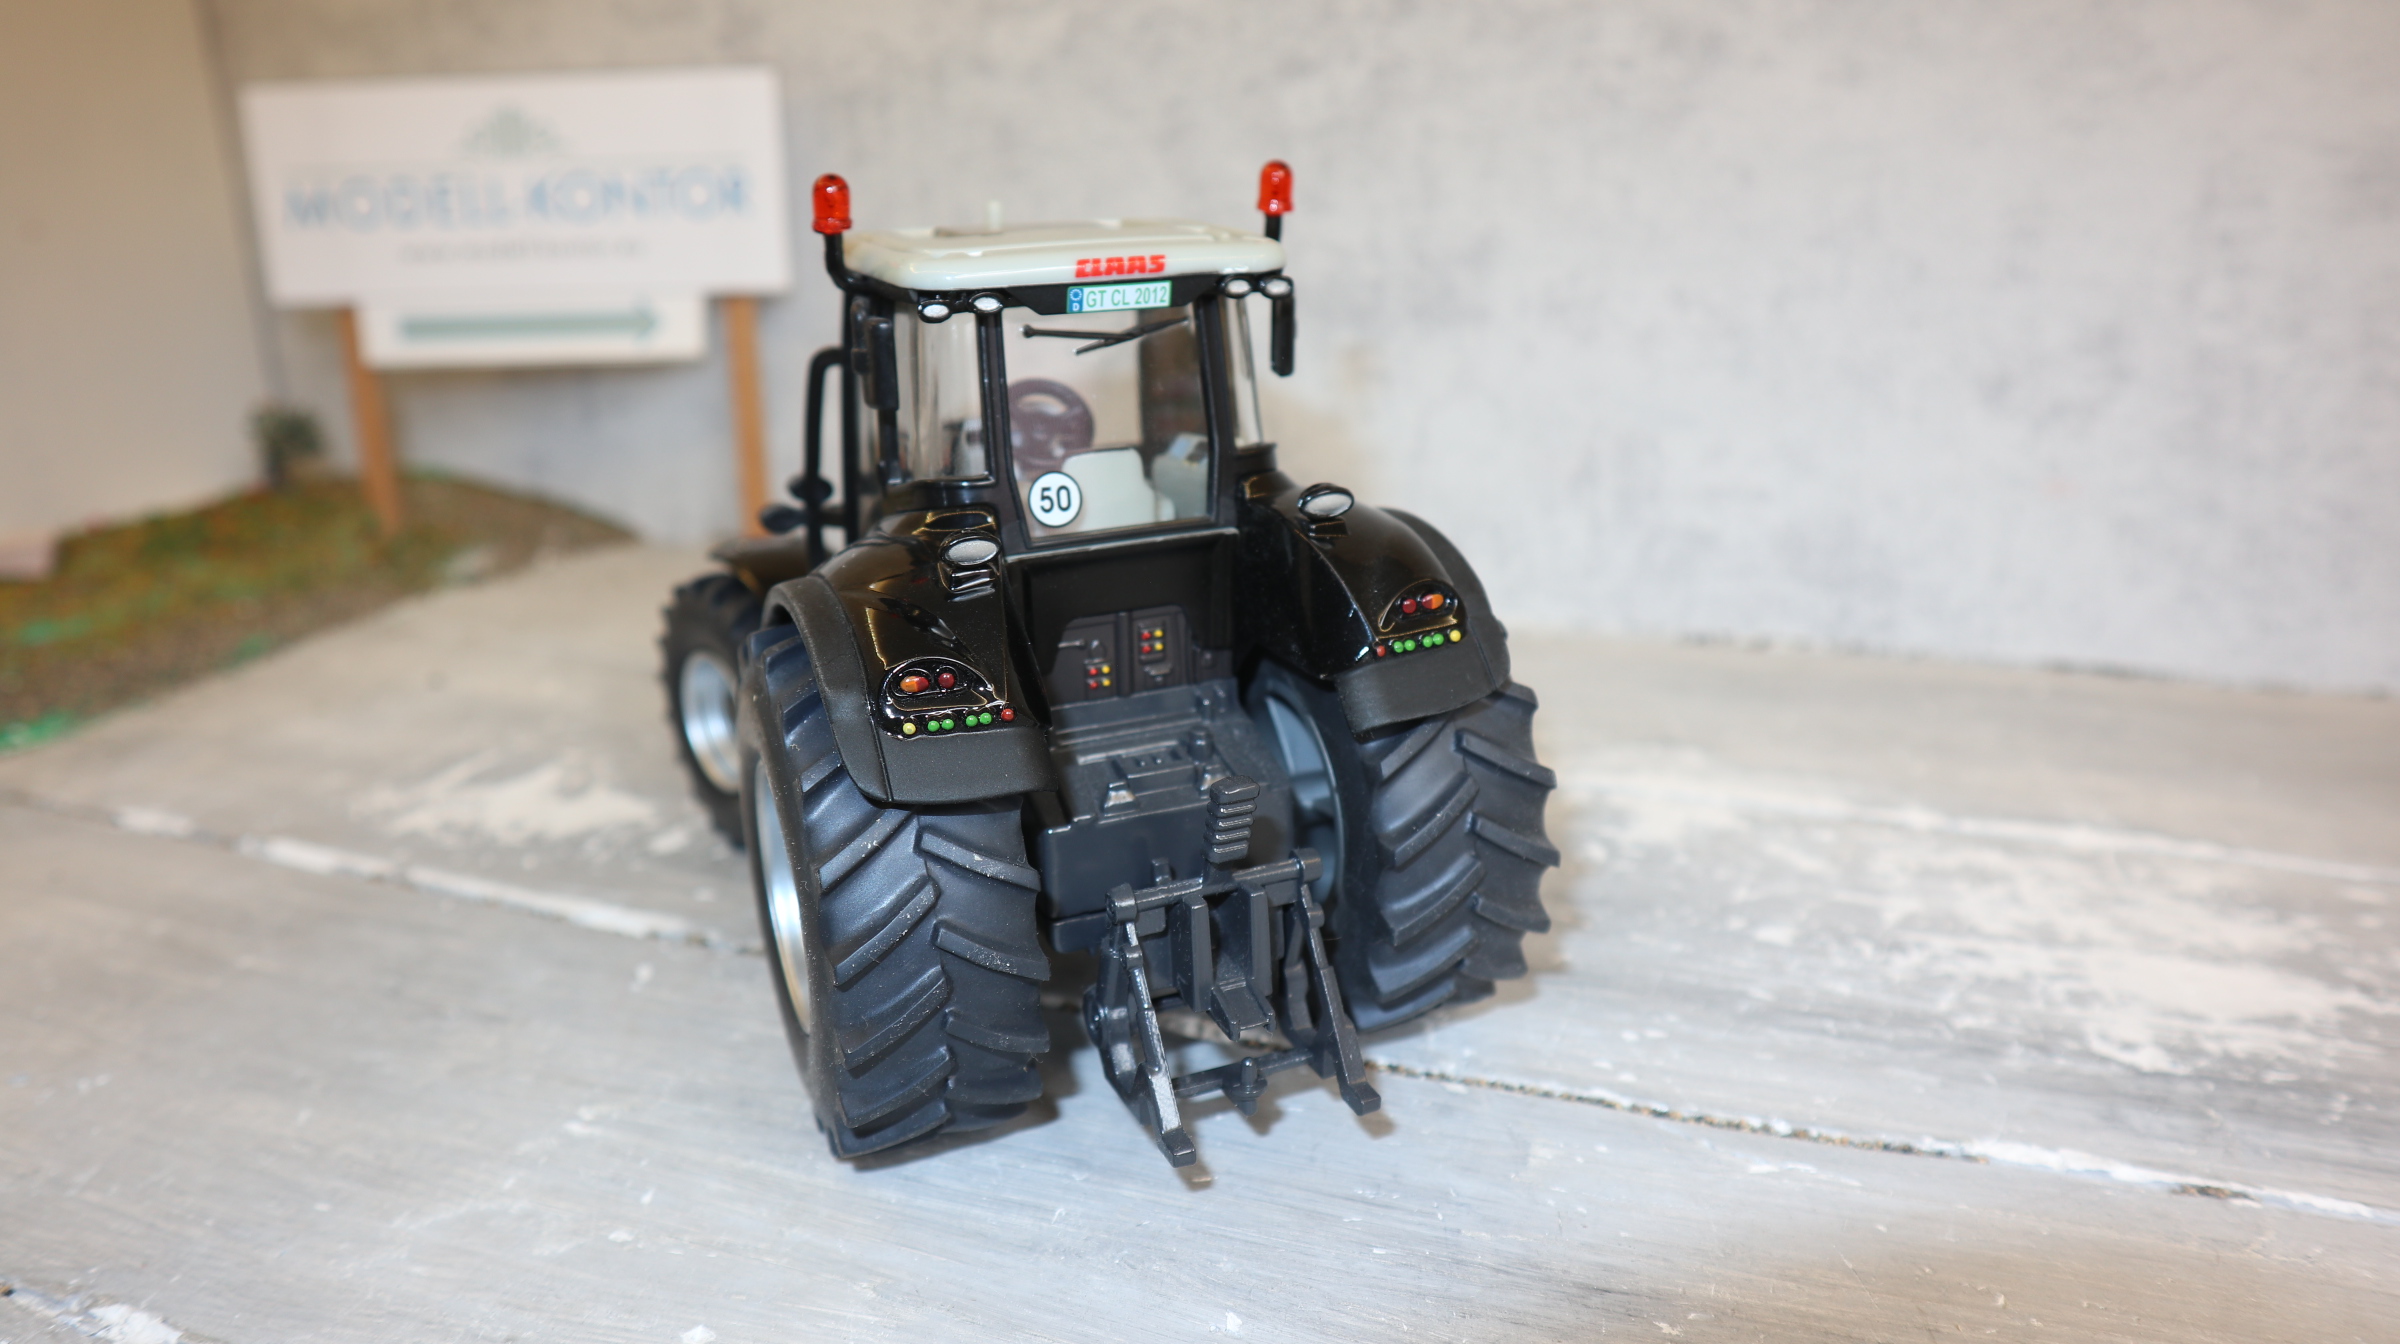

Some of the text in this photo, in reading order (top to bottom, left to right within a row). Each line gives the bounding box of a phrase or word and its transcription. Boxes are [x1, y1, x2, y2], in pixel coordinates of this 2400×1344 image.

[1075, 254, 1166, 278] CLAAS
[1072, 302, 1080, 312] D
[1085, 285, 1168, 308] GT CL 2012
[1040, 485, 1072, 513] 50
